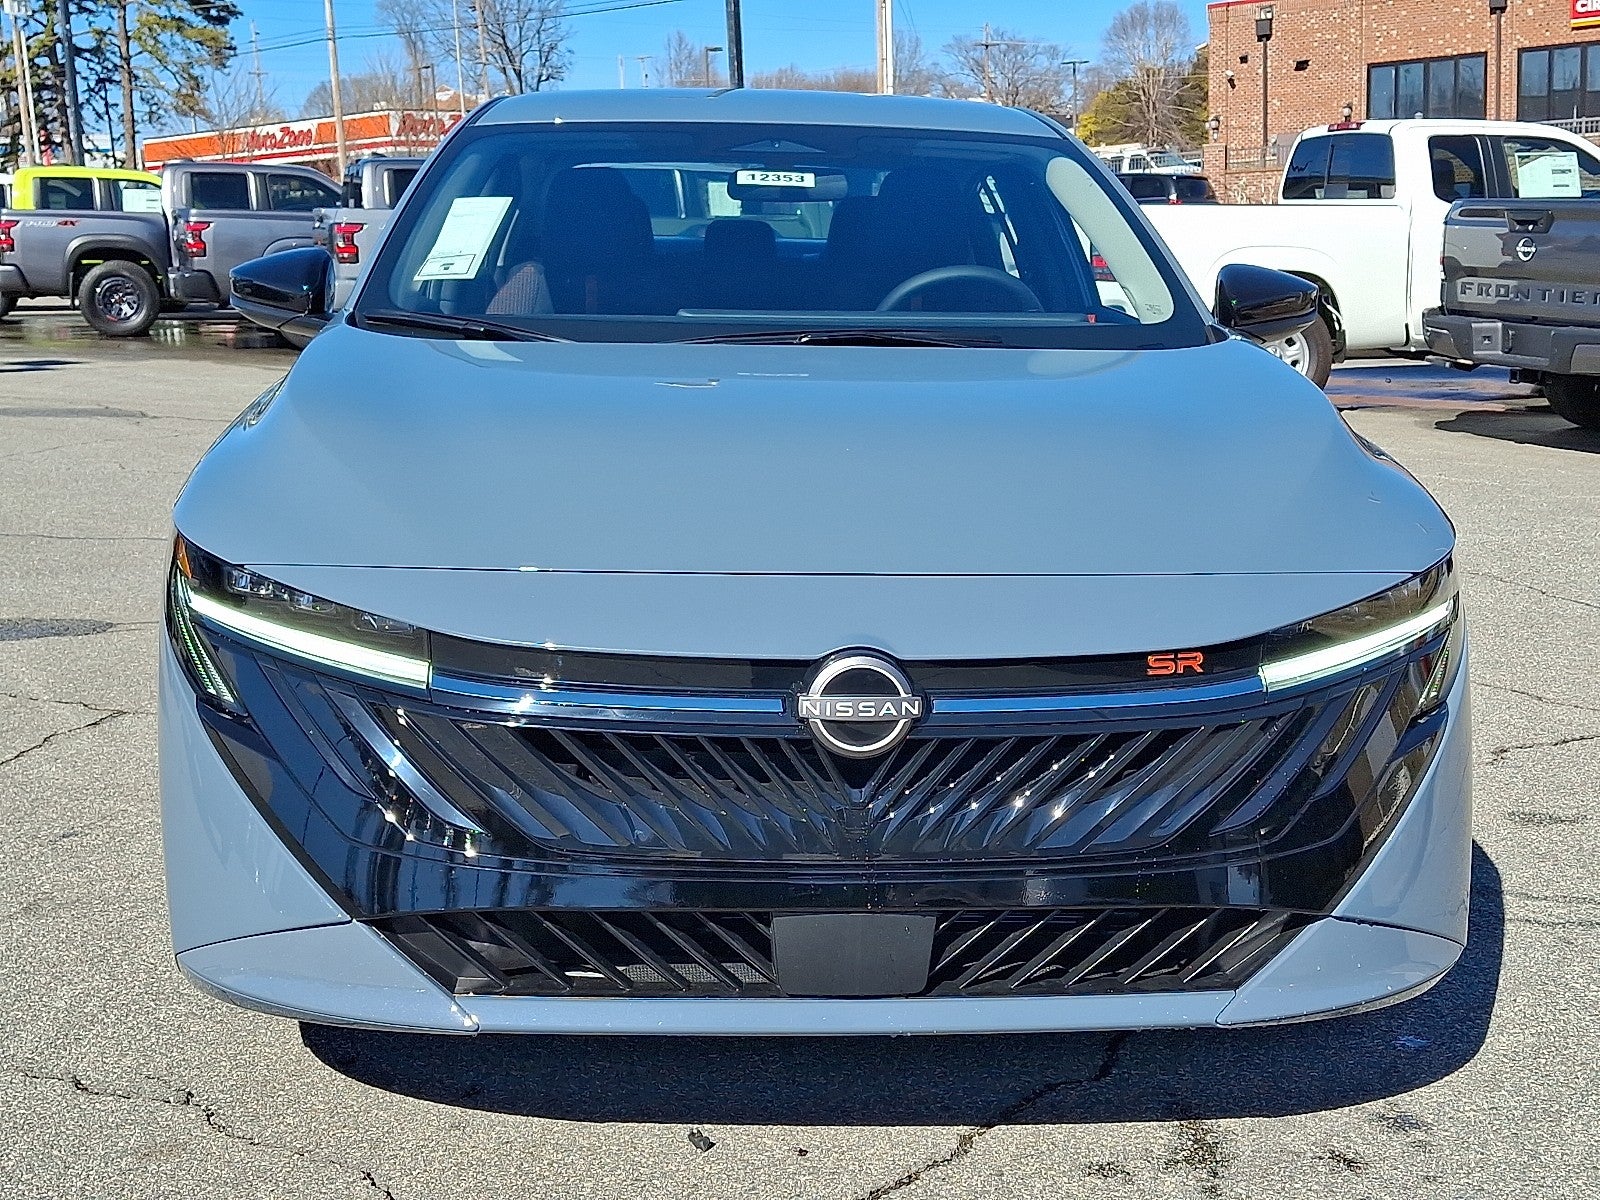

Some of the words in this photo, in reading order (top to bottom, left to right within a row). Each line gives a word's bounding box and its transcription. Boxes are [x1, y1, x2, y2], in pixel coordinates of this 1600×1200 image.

[246, 126, 313, 151] AutoZone
[745, 173, 805, 183] 12353
[1146, 651, 1204, 676] SR
[802, 700, 920, 717] NISSAN
